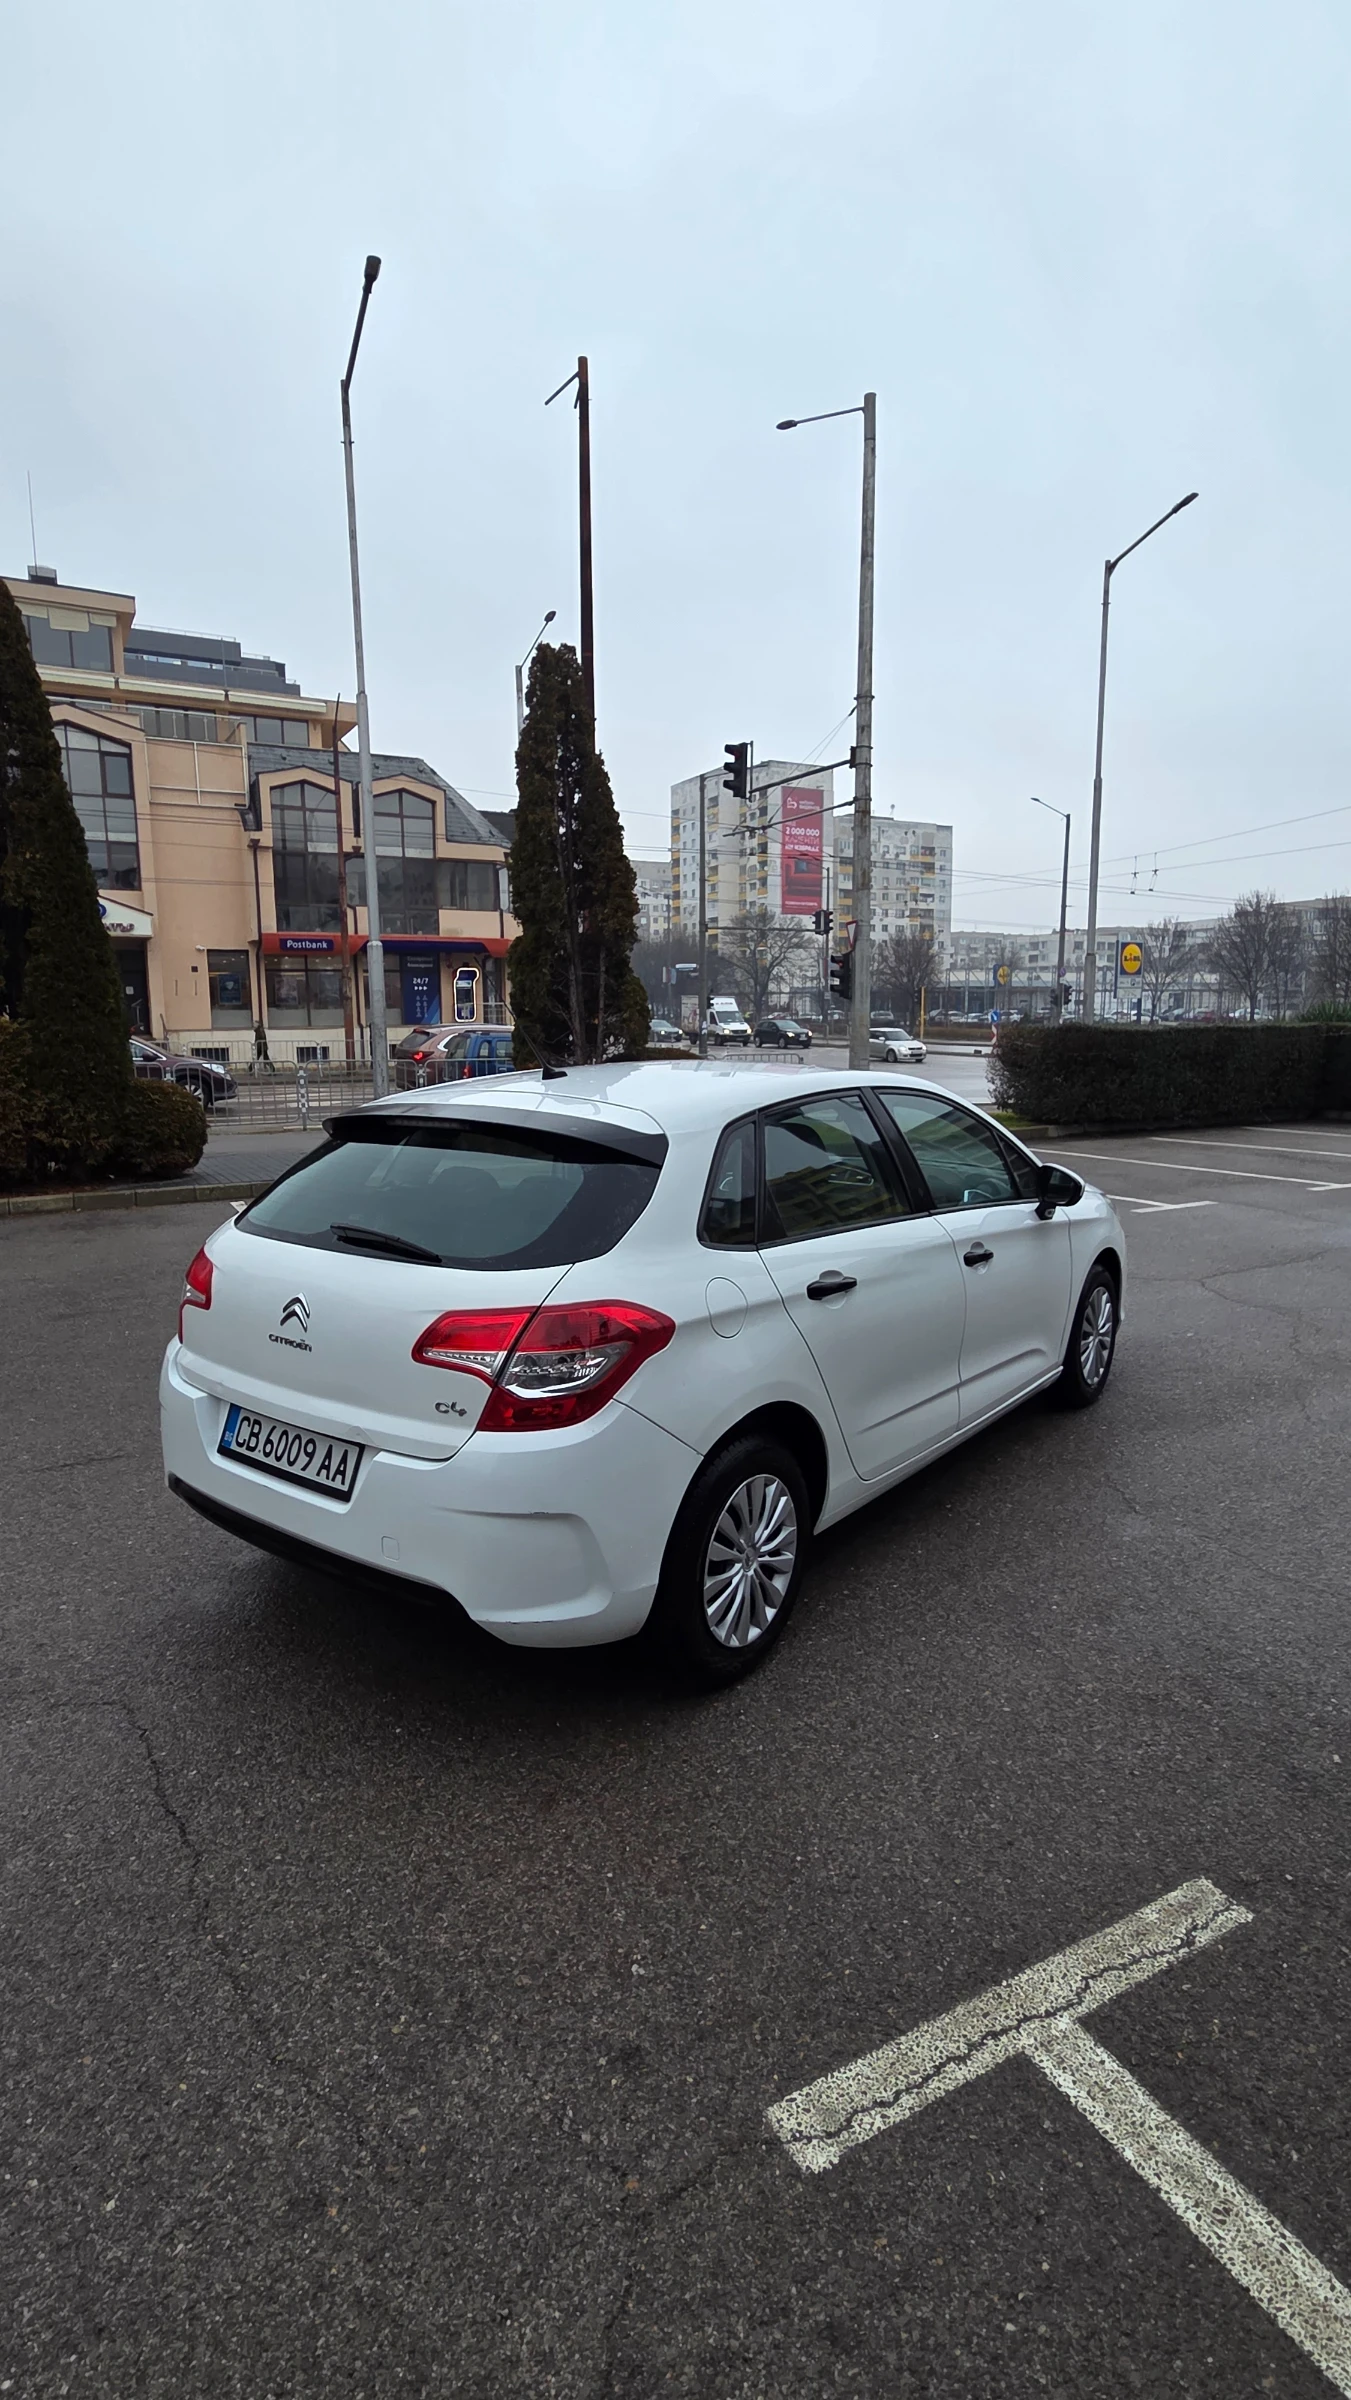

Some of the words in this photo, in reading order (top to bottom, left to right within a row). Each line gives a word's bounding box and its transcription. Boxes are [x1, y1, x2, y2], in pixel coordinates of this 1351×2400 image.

[790, 827, 805, 836] 000
[805, 828, 820, 837] 000
[286, 939, 328, 949] Postbank
[412, 977, 429, 985] 24/7
[434, 1401, 468, 1417] C4
